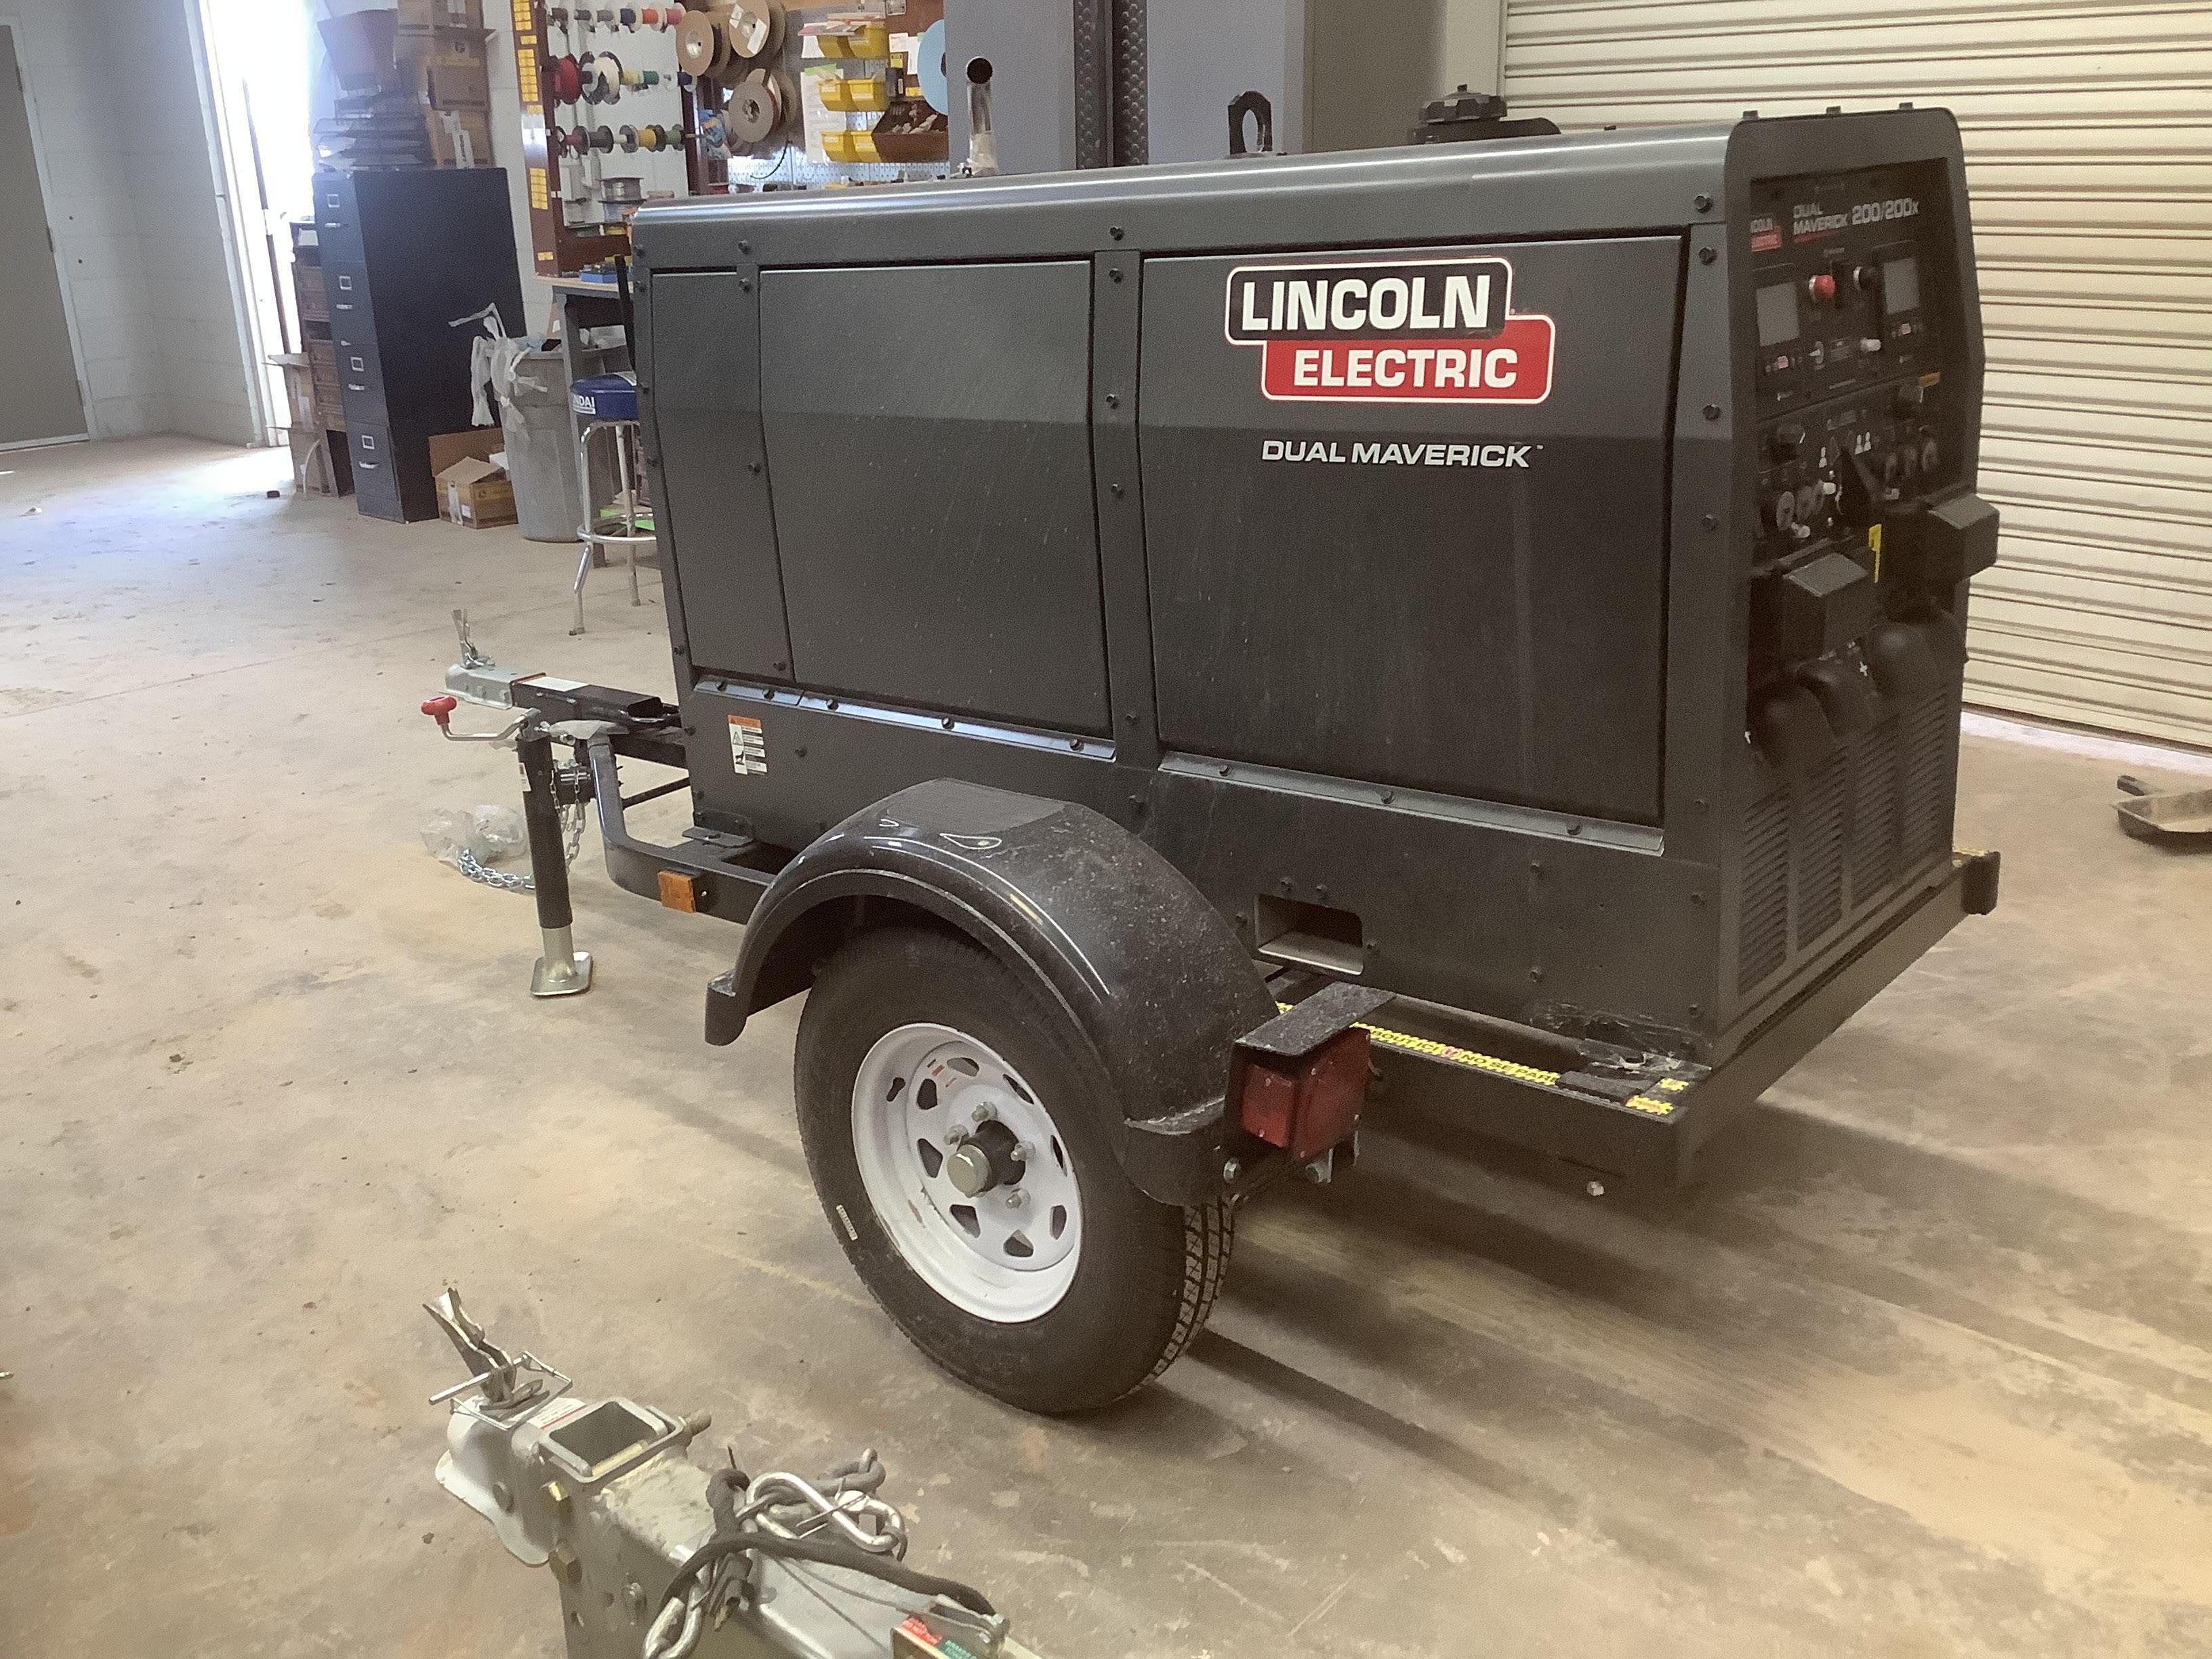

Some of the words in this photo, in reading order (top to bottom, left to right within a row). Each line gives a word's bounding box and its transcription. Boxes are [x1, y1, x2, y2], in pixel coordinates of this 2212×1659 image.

[1241, 274, 1491, 331] LINCOLN
[1293, 348, 1518, 389] ELECTRIC
[1262, 440, 1347, 463] DUAL
[1351, 443, 1533, 468] MAVERICK
[1461, 1054, 1488, 1065] NO
